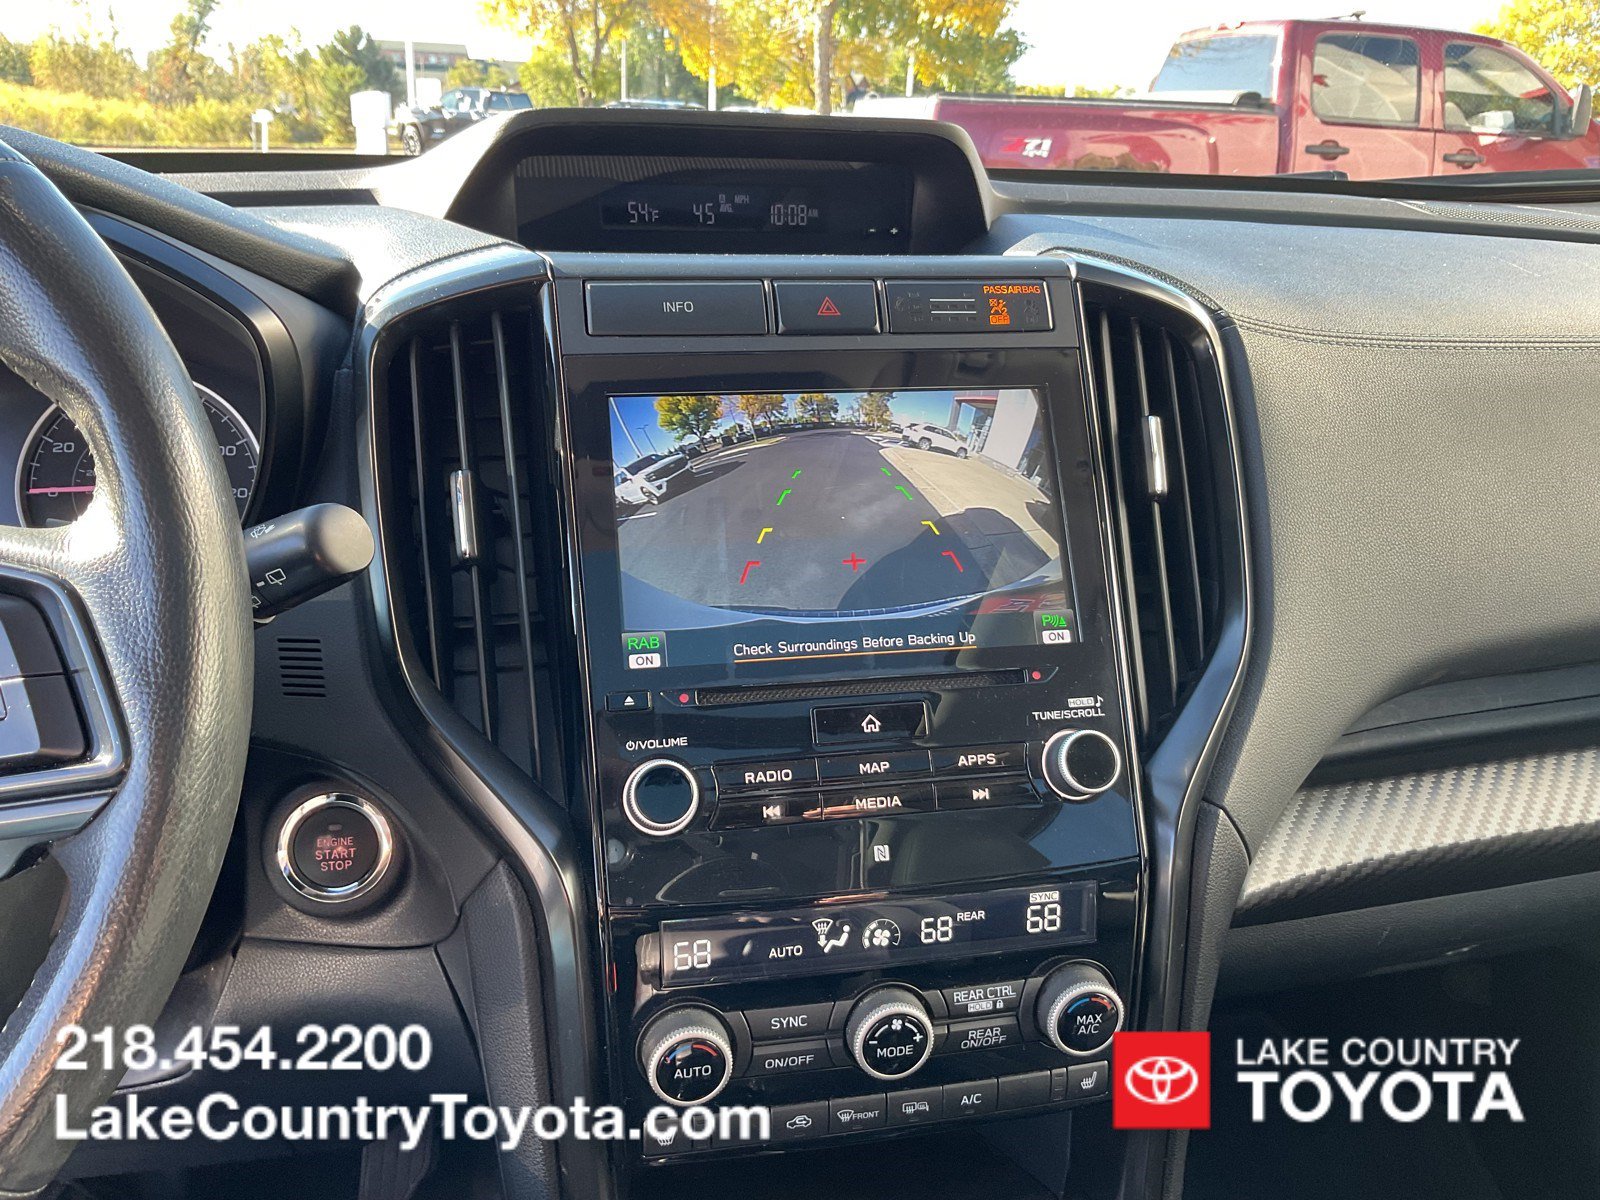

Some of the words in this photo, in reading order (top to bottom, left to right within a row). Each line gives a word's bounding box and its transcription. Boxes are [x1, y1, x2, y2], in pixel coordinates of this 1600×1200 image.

[734, 194, 750, 204] MPH
[693, 203, 715, 225] 45
[770, 204, 807, 226] 10:08
[662, 301, 694, 313] INFO
[52, 442, 75, 453] 20
[627, 636, 660, 650] RAB
[733, 643, 773, 656] Check
[777, 639, 858, 654] Surroundings
[862, 635, 904, 649] Before
[907, 633, 955, 647] Backing
[958, 631, 977, 644] Up
[1048, 632, 1065, 642] ON
[635, 655, 654, 666] ON
[1069, 698, 1094, 707] HOLD
[1032, 708, 1106, 722] TUNE/SCROLL
[957, 753, 997, 767] APPS
[859, 761, 891, 775] MAP
[744, 769, 793, 784] RADIO
[855, 795, 902, 810] MEDIA
[317, 837, 354, 847] ENGINE
[315, 848, 356, 860] START
[320, 860, 353, 871] STOP
[1030, 891, 1059, 902] SYNC
[956, 909, 986, 922] REAR
[1026, 904, 1062, 933] 68
[920, 916, 954, 943] 68
[673, 939, 713, 971] 68
[768, 944, 804, 959] AUTO
[953, 989, 984, 1003] REAR
[986, 985, 1017, 999] CTRL
[968, 1001, 992, 1012] HOLD
[770, 1014, 808, 1030] SYNC
[1076, 1013, 1103, 1026] MAX
[968, 1027, 1001, 1040] REAR
[1077, 1022, 1100, 1035] A/C
[960, 1034, 1007, 1050] ON/OFF
[876, 1043, 914, 1058] MODE
[764, 1054, 815, 1069] ON/OFF
[673, 1063, 712, 1079] AUTO
[960, 1093, 982, 1105] A/C
[852, 1110, 880, 1121] FRONT
